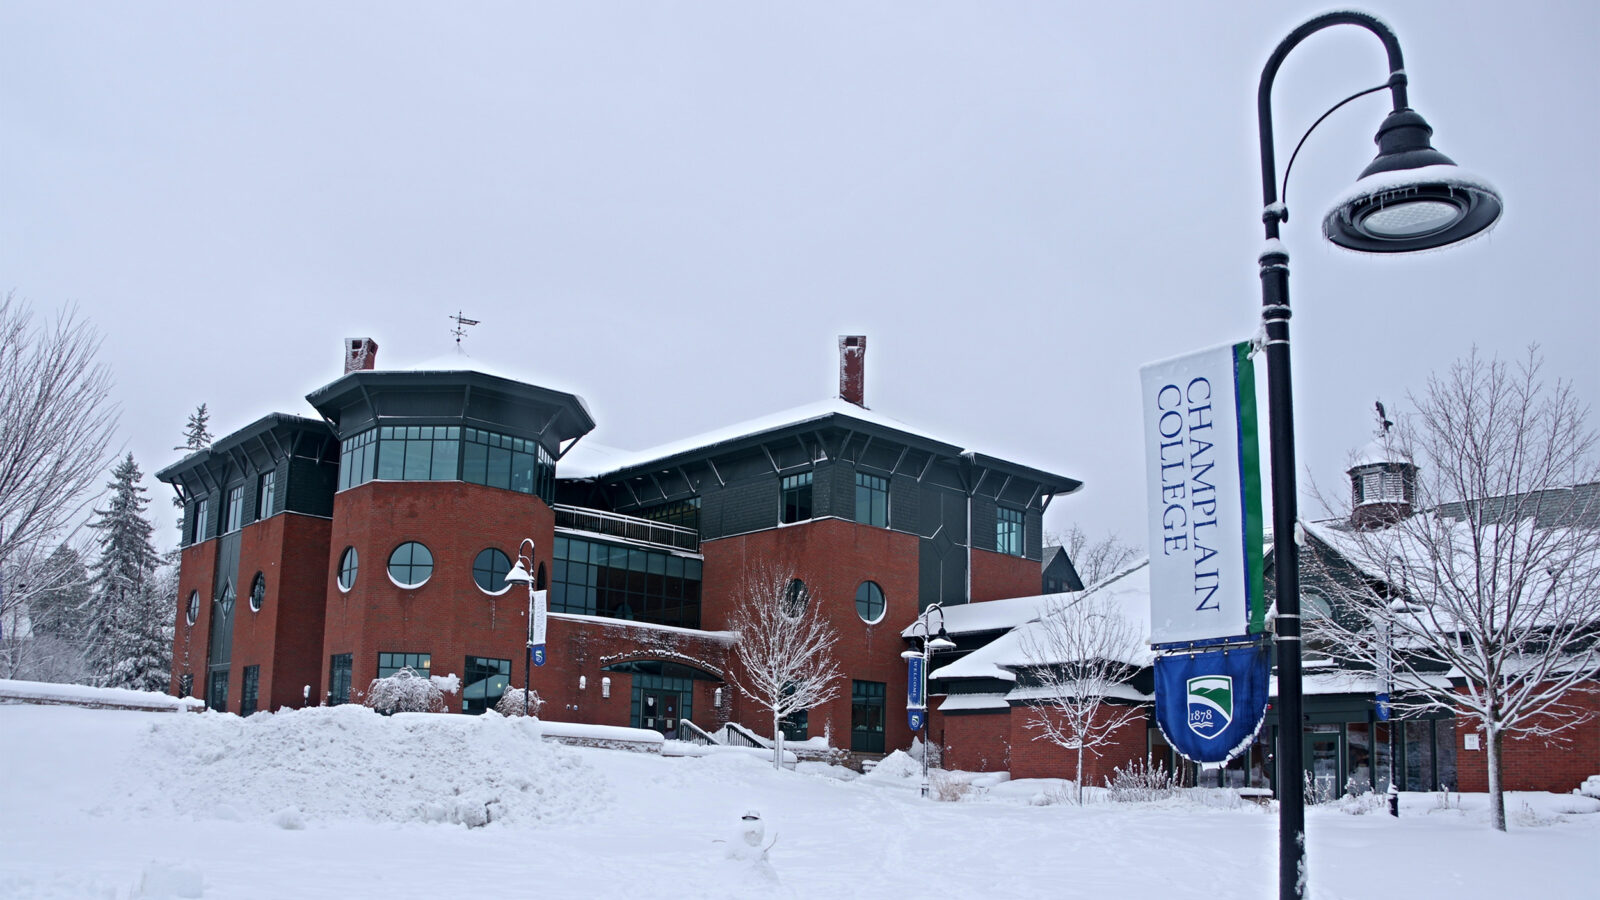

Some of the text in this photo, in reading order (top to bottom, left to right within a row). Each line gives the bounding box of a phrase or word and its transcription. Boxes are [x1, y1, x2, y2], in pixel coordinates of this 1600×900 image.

[1157, 383, 1189, 557] COLLEGE
[1186, 376, 1221, 612] CHAMPLAIN
[1190, 709, 1213, 722] 1878
